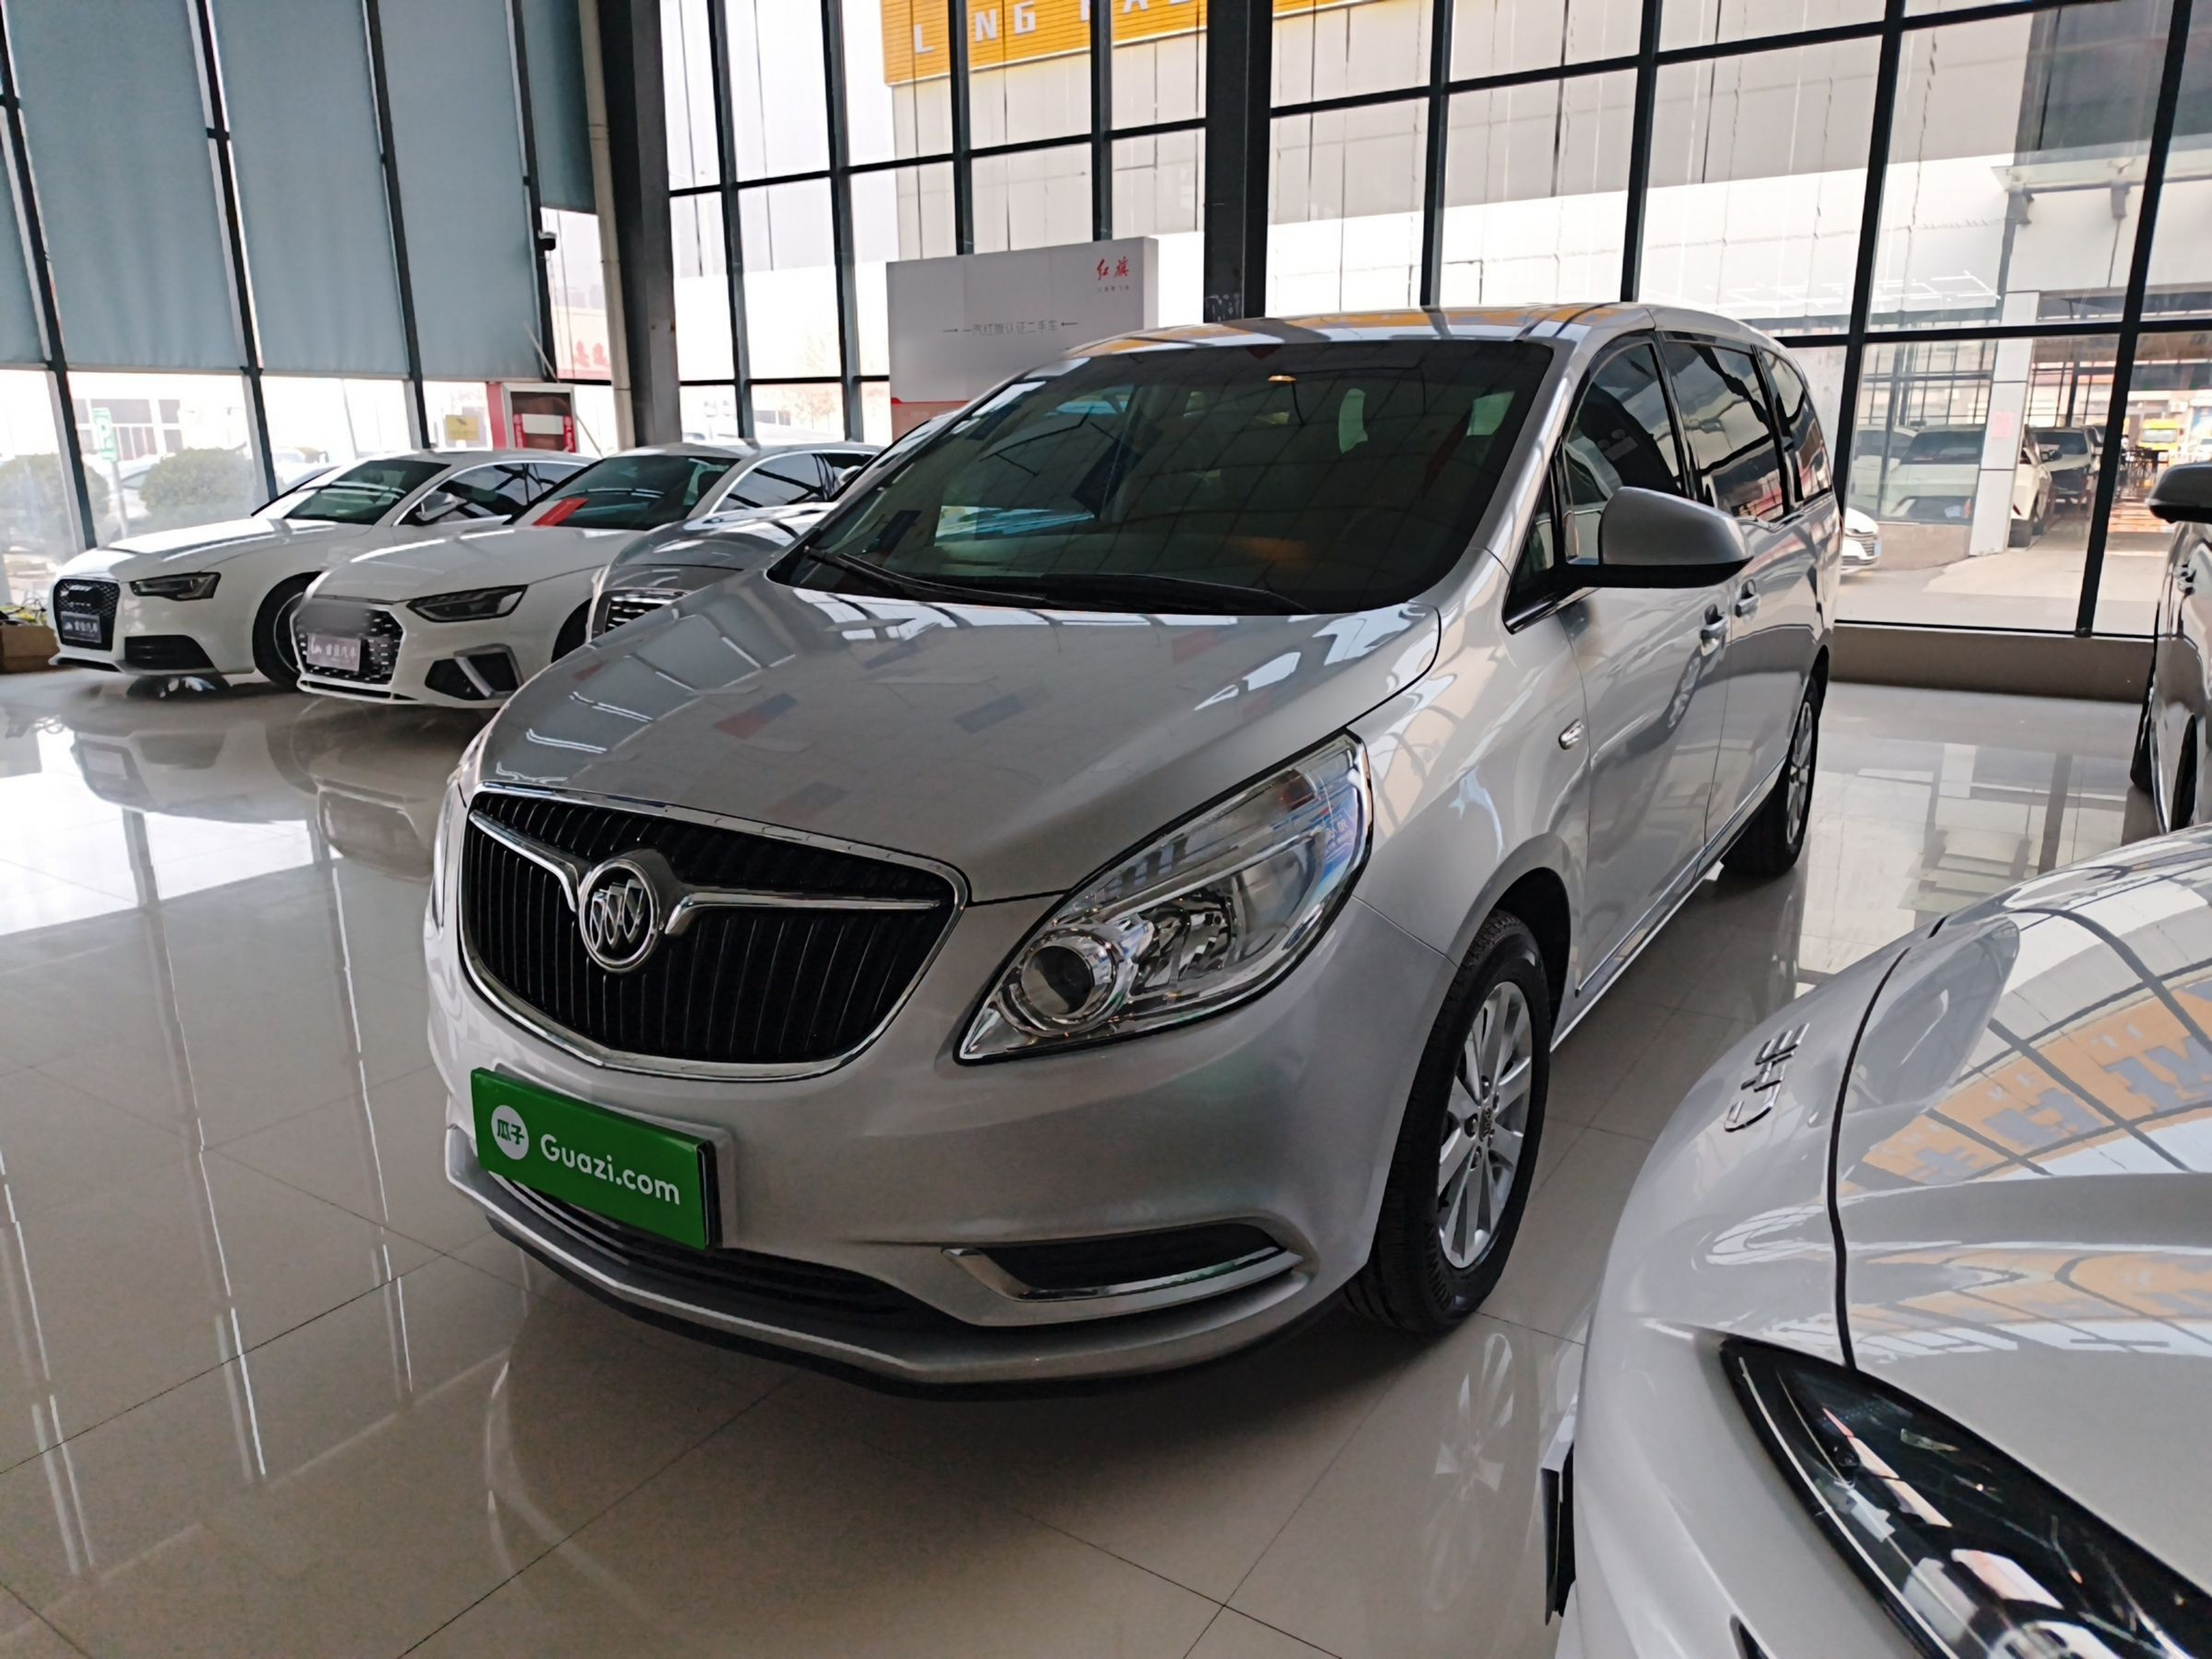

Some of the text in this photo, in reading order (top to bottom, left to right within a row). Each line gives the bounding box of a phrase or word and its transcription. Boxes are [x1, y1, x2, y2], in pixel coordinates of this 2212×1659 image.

[1097, 255, 1130, 281] 红旗
[497, 1119, 525, 1145] 瓜子
[540, 1134, 680, 1205] Guazi.com
